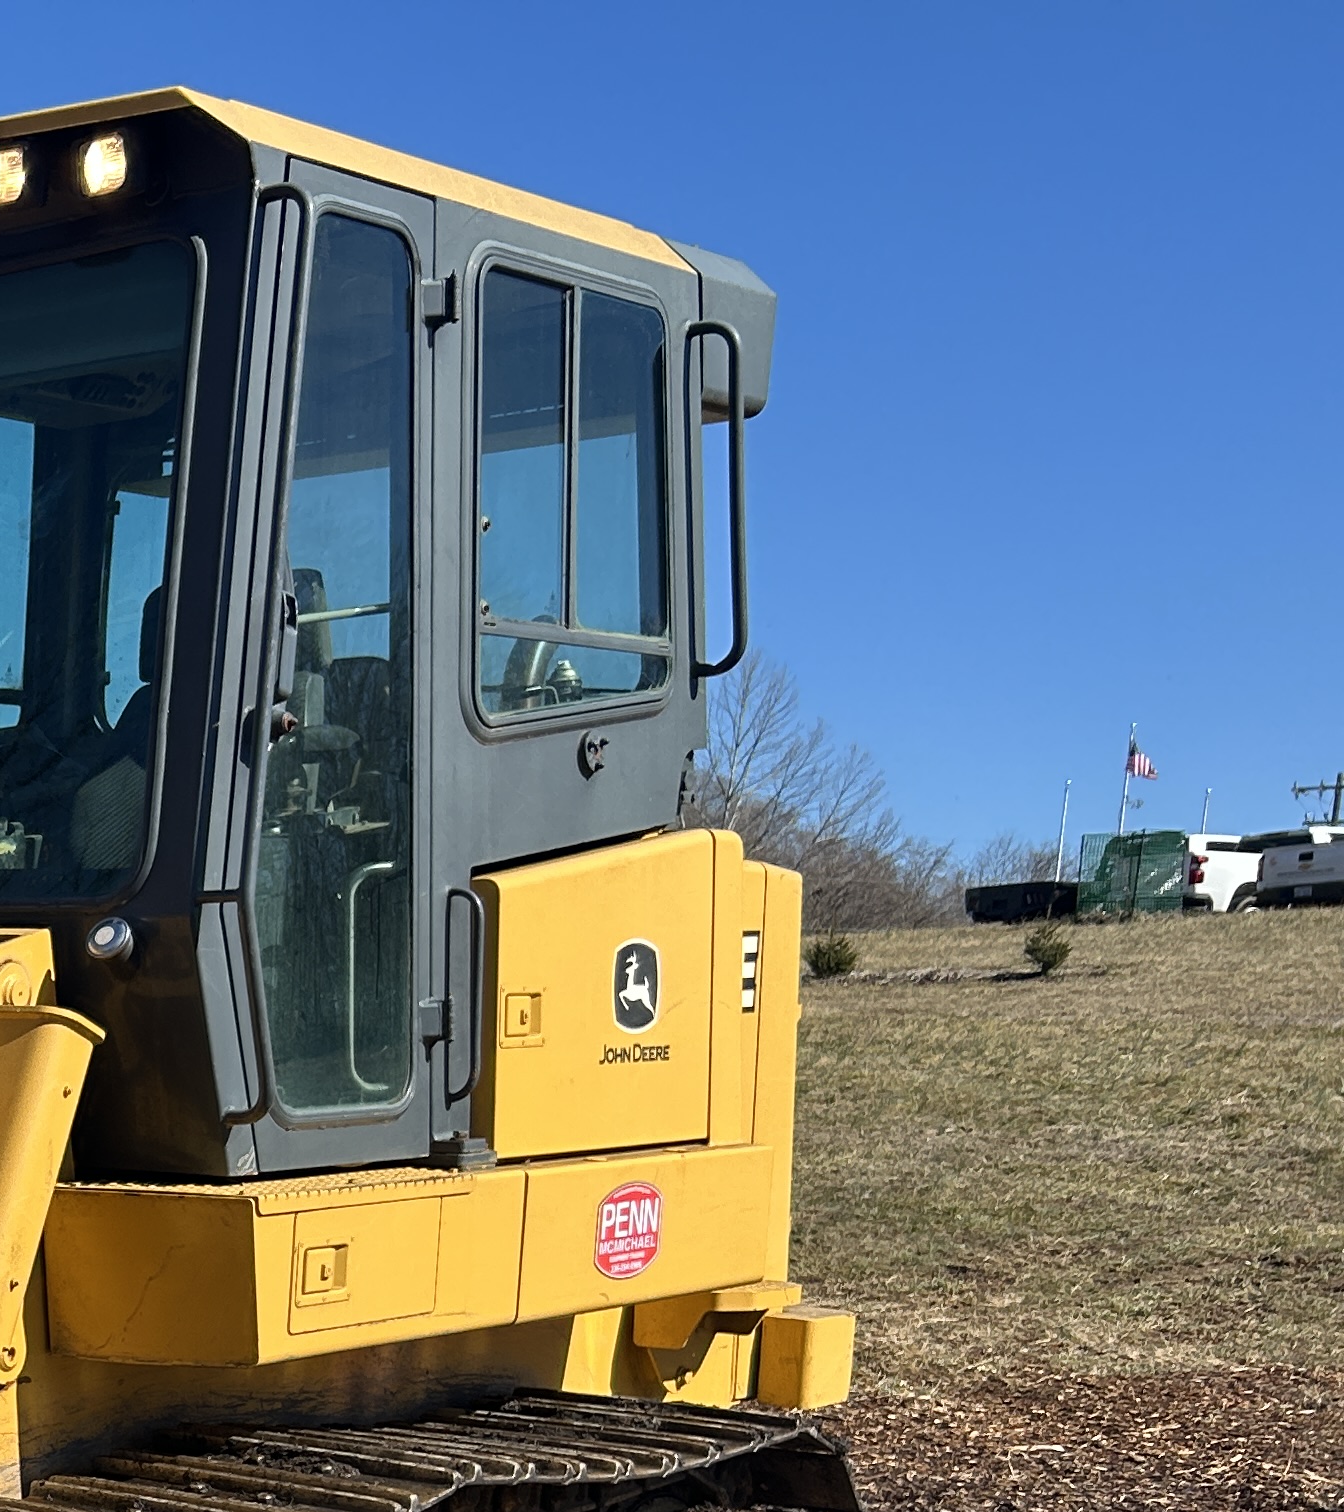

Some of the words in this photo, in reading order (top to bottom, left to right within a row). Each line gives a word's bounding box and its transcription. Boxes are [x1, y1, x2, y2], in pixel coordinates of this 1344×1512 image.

[599, 1043, 632, 1065] JOHN
[632, 1042, 670, 1063] DEERE
[600, 1197, 660, 1241] PENN
